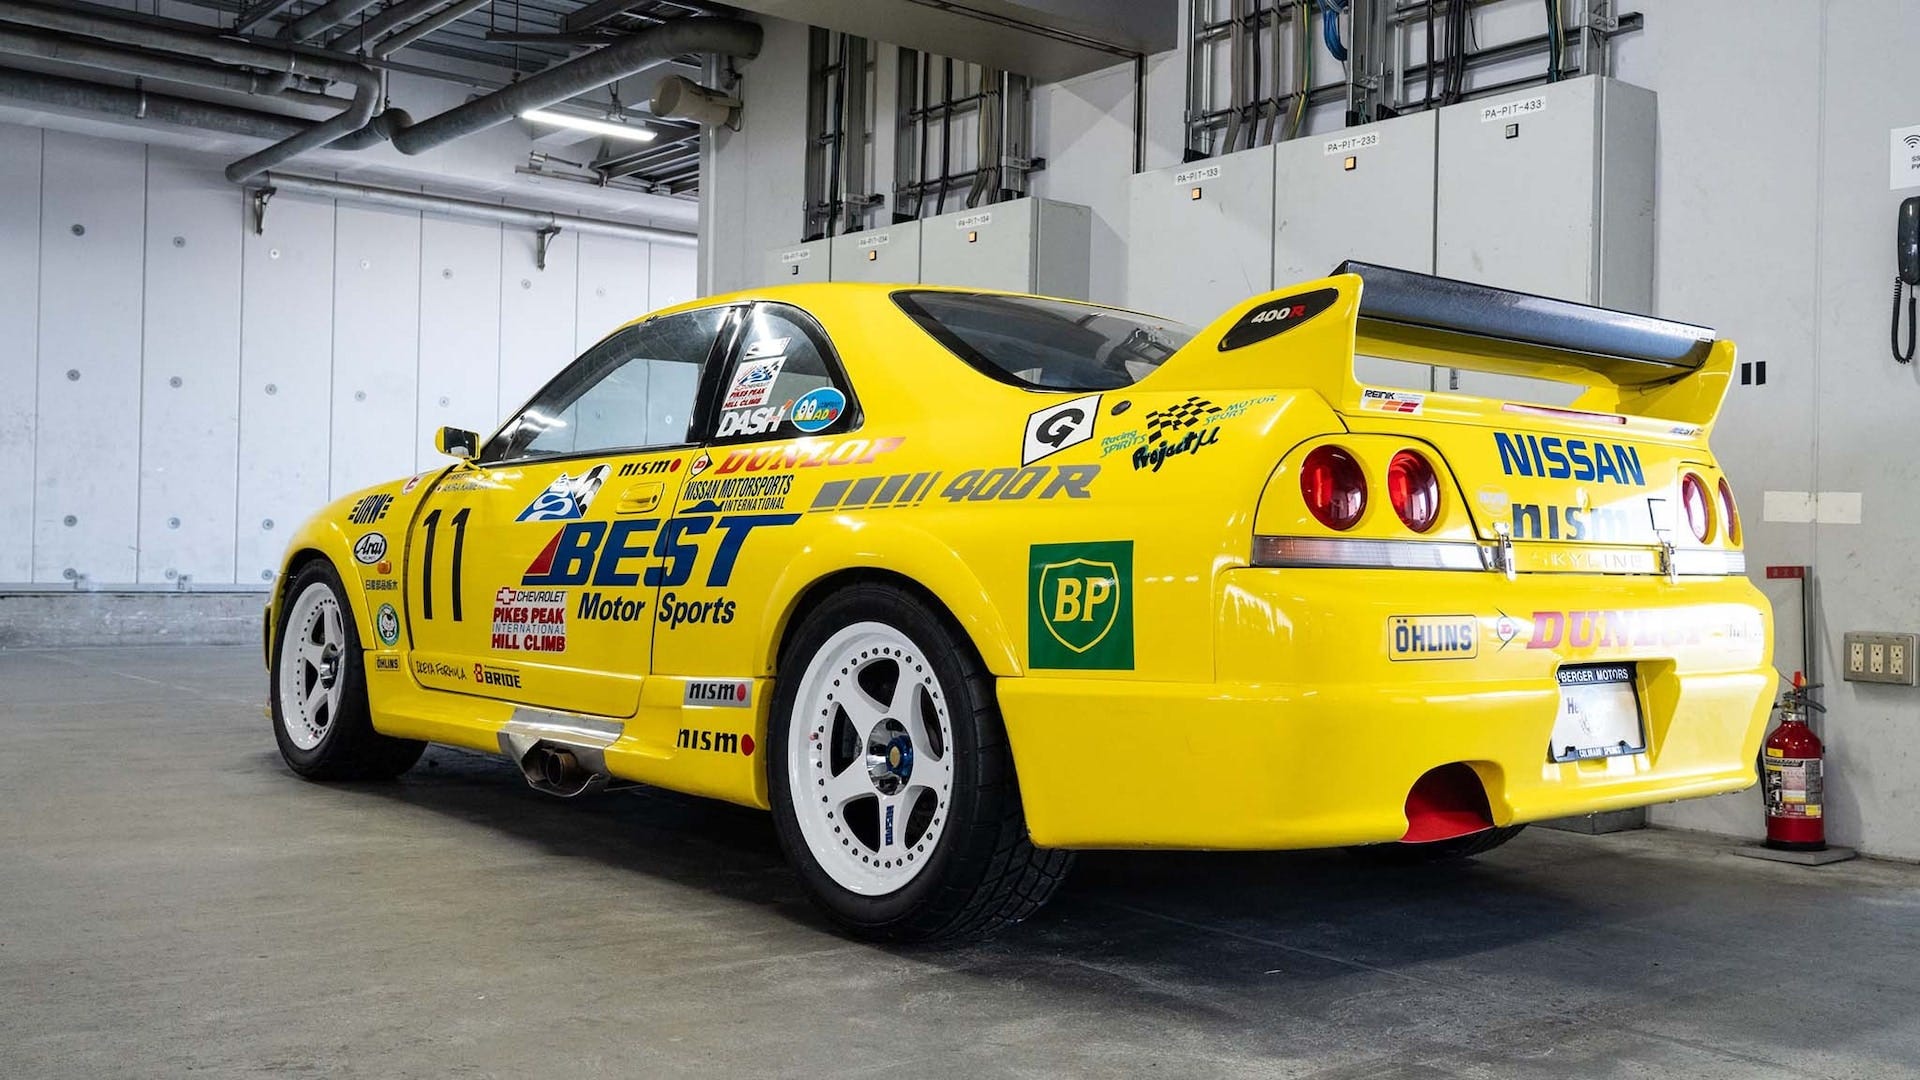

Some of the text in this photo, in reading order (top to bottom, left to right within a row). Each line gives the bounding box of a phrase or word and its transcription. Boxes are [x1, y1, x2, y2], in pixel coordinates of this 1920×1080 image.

[1485, 100, 1542, 120] PA-PIT-433
[1326, 135, 1377, 153] PA-PIT-233
[1177, 167, 1218, 184] PA-PIT-133
[1250, 304, 1306, 324] 400R
[1226, 395, 1277, 411] MOTOR
[715, 407, 784, 438] DASH
[1203, 408, 1247, 426] SPORT
[1035, 407, 1084, 449] G
[1494, 432, 1646, 487] NISSAN
[683, 475, 794, 501] NISSAN MOTORSPORTS
[940, 465, 1101, 503] 400R
[723, 496, 785, 512] INTERNATIONAL
[356, 536, 383, 555] Arai
[521, 513, 803, 588] BEST
[422, 508, 471, 621] 11
[516, 591, 566, 603] CHEVROLET
[1053, 577, 1110, 621] BP
[493, 607, 565, 625] PIKES PEAK
[578, 592, 736, 630] Motor Sports
[492, 624, 566, 635] INTERNATIONAL
[1394, 619, 1473, 653] ÖHLINS
[491, 634, 566, 652] HILL CLIMB
[435, 662, 467, 680] FORMULA
[484, 671, 522, 689] BRIDE
[1595, 668, 1629, 681] MOTORS
